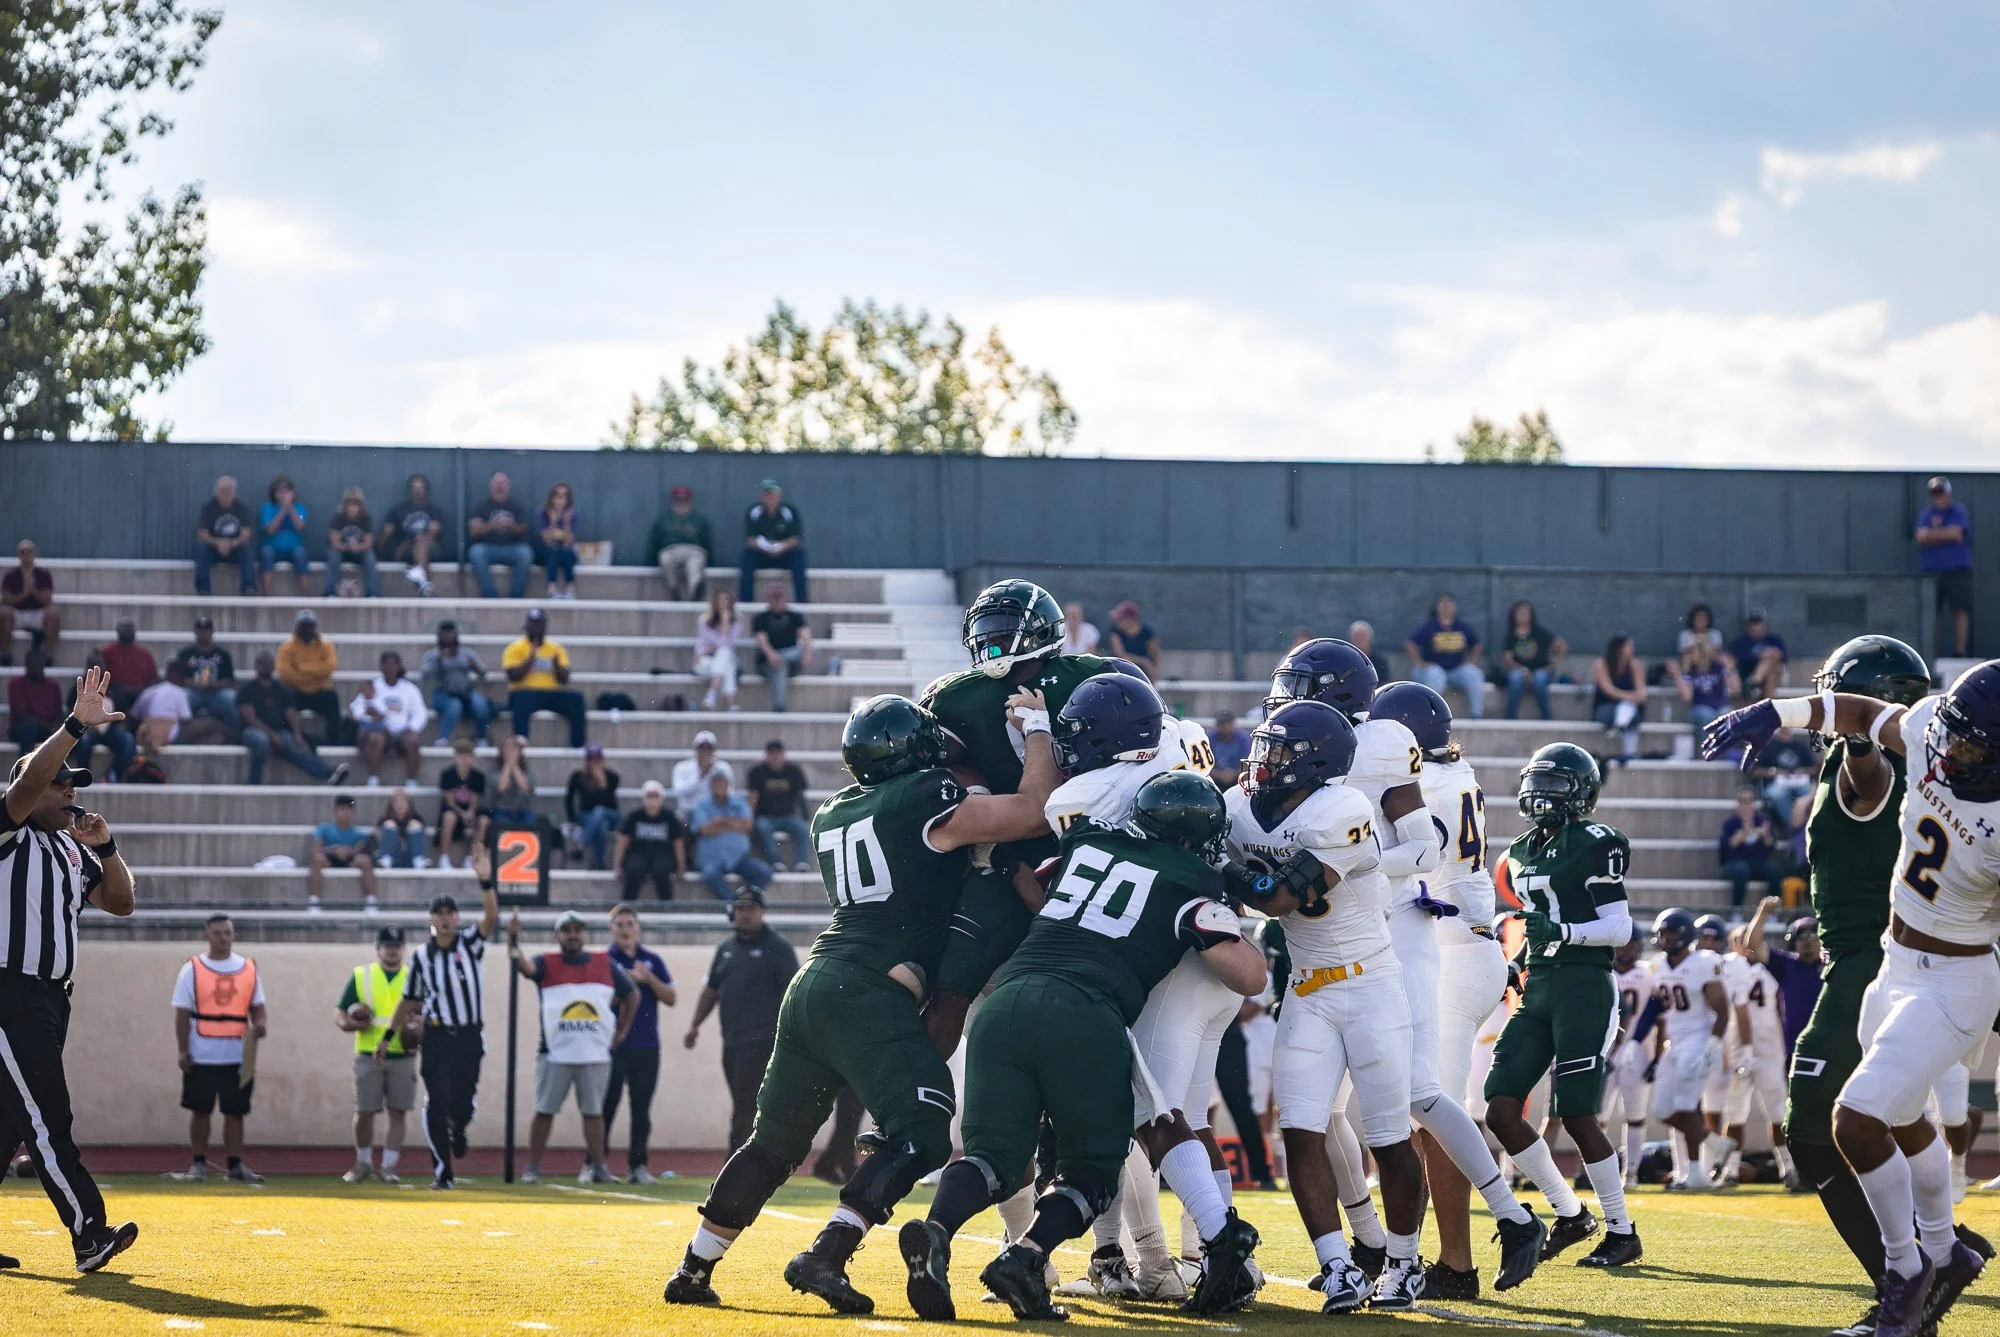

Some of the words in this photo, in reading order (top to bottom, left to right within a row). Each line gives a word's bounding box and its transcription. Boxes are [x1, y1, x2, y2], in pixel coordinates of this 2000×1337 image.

[1242, 843, 1292, 858] MUSTANGS
[1916, 780, 1975, 845] MUSTANGS
[497, 830, 540, 883] 2
[816, 815, 894, 907] 70
[1038, 844, 1159, 939] 50
[1904, 814, 1950, 904] 2
